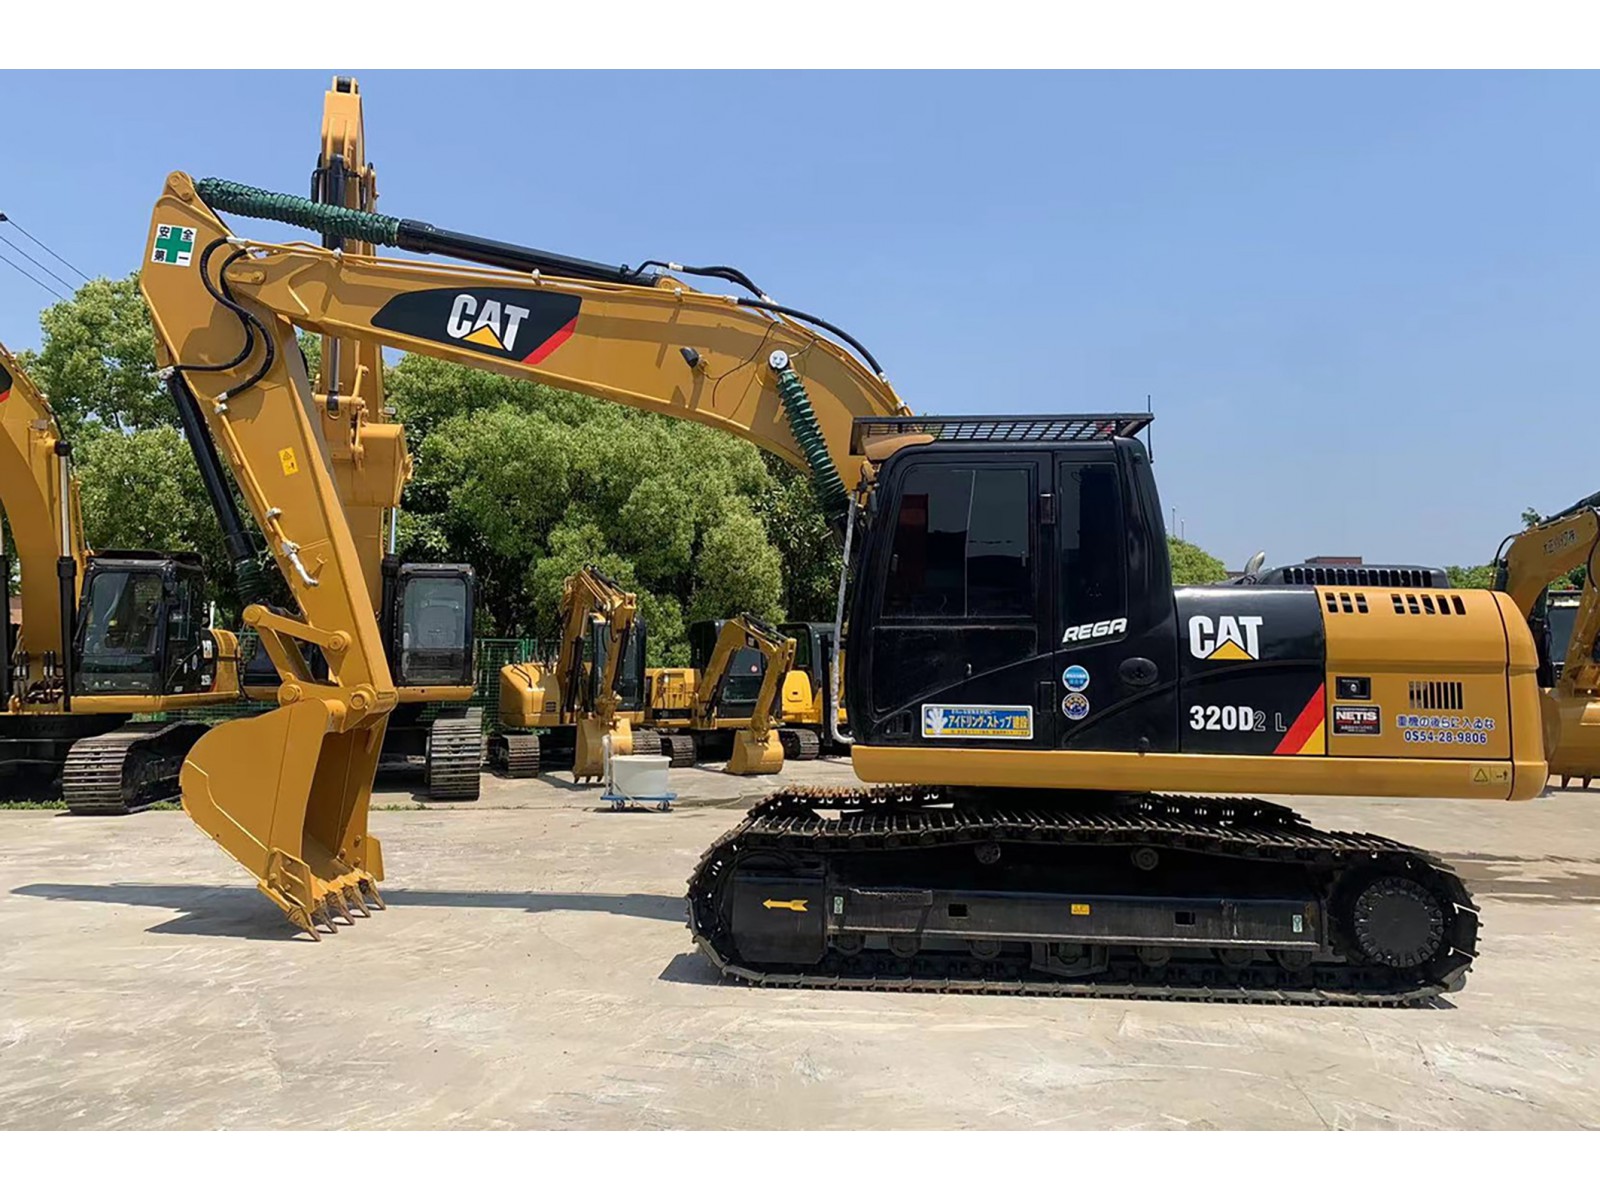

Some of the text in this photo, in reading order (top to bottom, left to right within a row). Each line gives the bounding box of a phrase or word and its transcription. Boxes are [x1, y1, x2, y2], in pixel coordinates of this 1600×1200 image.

[446, 293, 531, 352] CAT
[1062, 617, 1128, 643] REGA
[1188, 615, 1263, 660] CAT
[1335, 711, 1378, 721] NETIS
